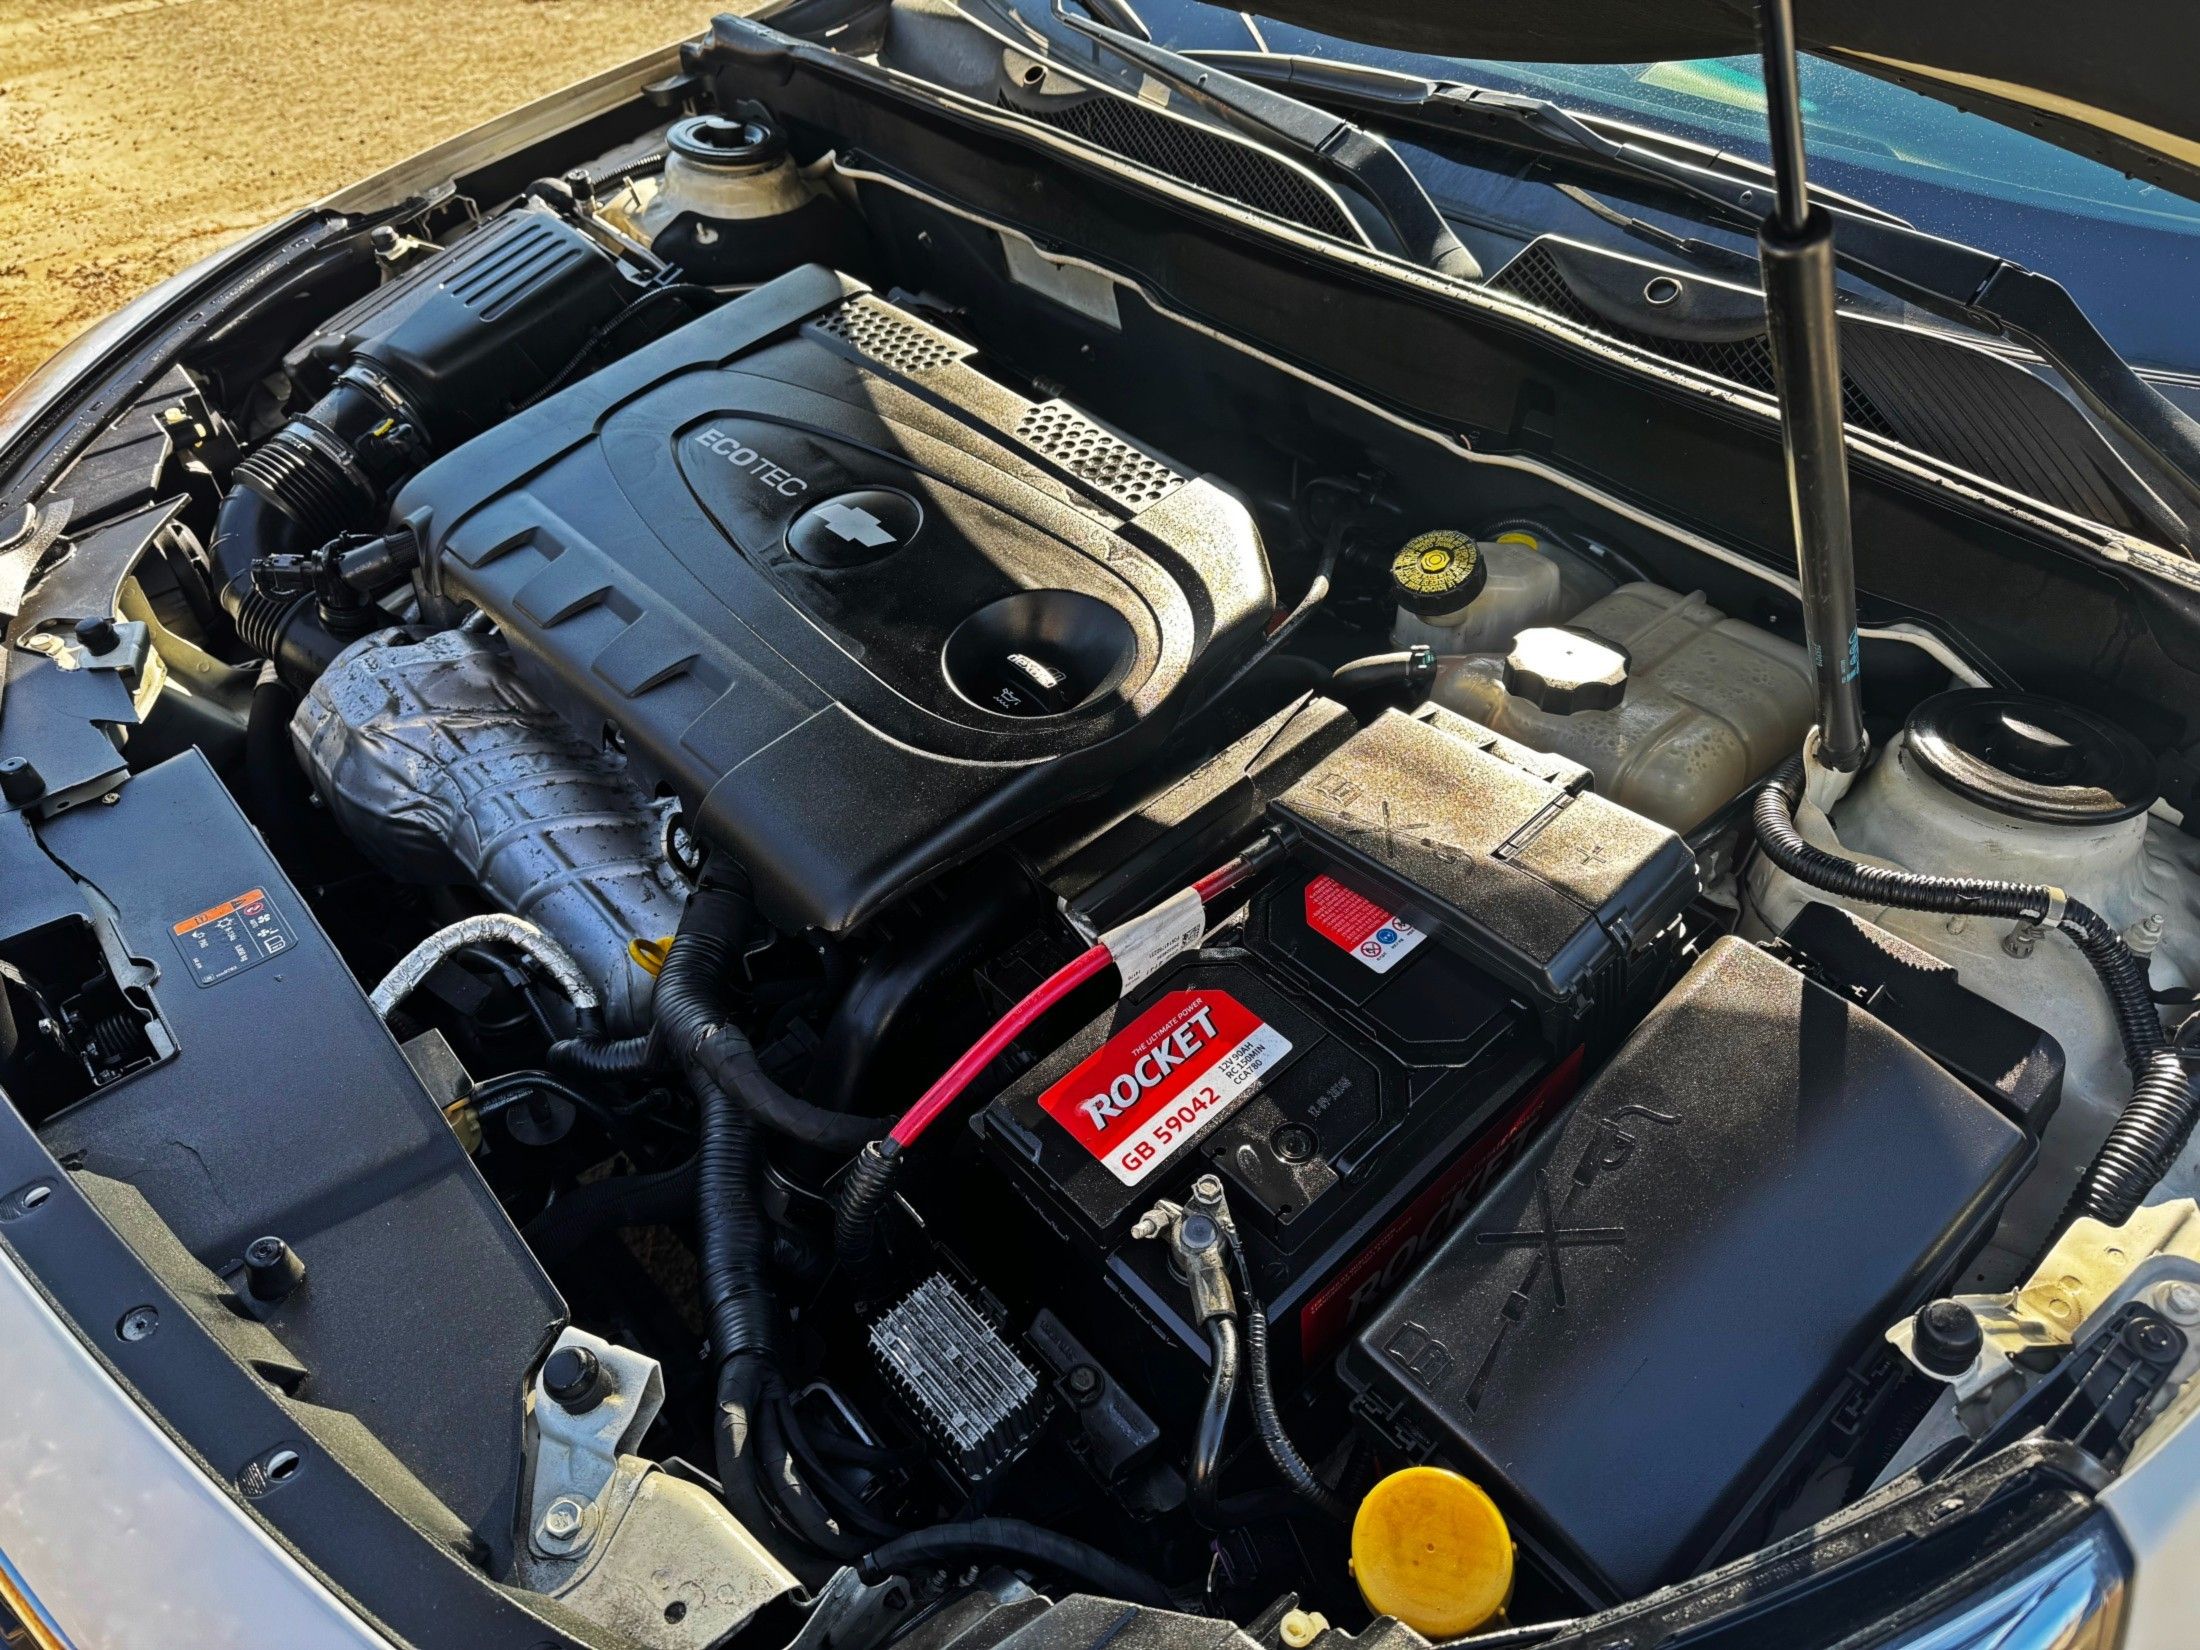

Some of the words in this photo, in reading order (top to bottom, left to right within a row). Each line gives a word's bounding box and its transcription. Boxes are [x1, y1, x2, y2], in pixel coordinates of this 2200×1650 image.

[695, 428, 808, 497] ECOTEC
[1131, 1042, 1147, 1056] THE
[1146, 1016, 1179, 1046] ULTIMATE
[1177, 997, 1203, 1020] POWER
[1081, 1005, 1219, 1131] ROCKET
[1218, 1058, 1234, 1072] 12V
[1232, 1041, 1254, 1061] 90AH
[1225, 1067, 1239, 1079] RC
[1236, 1044, 1266, 1069] 150MIN
[1233, 1059, 1263, 1085] CCA780
[1121, 1141, 1156, 1172] GB
[1153, 1086, 1221, 1145] 59042
